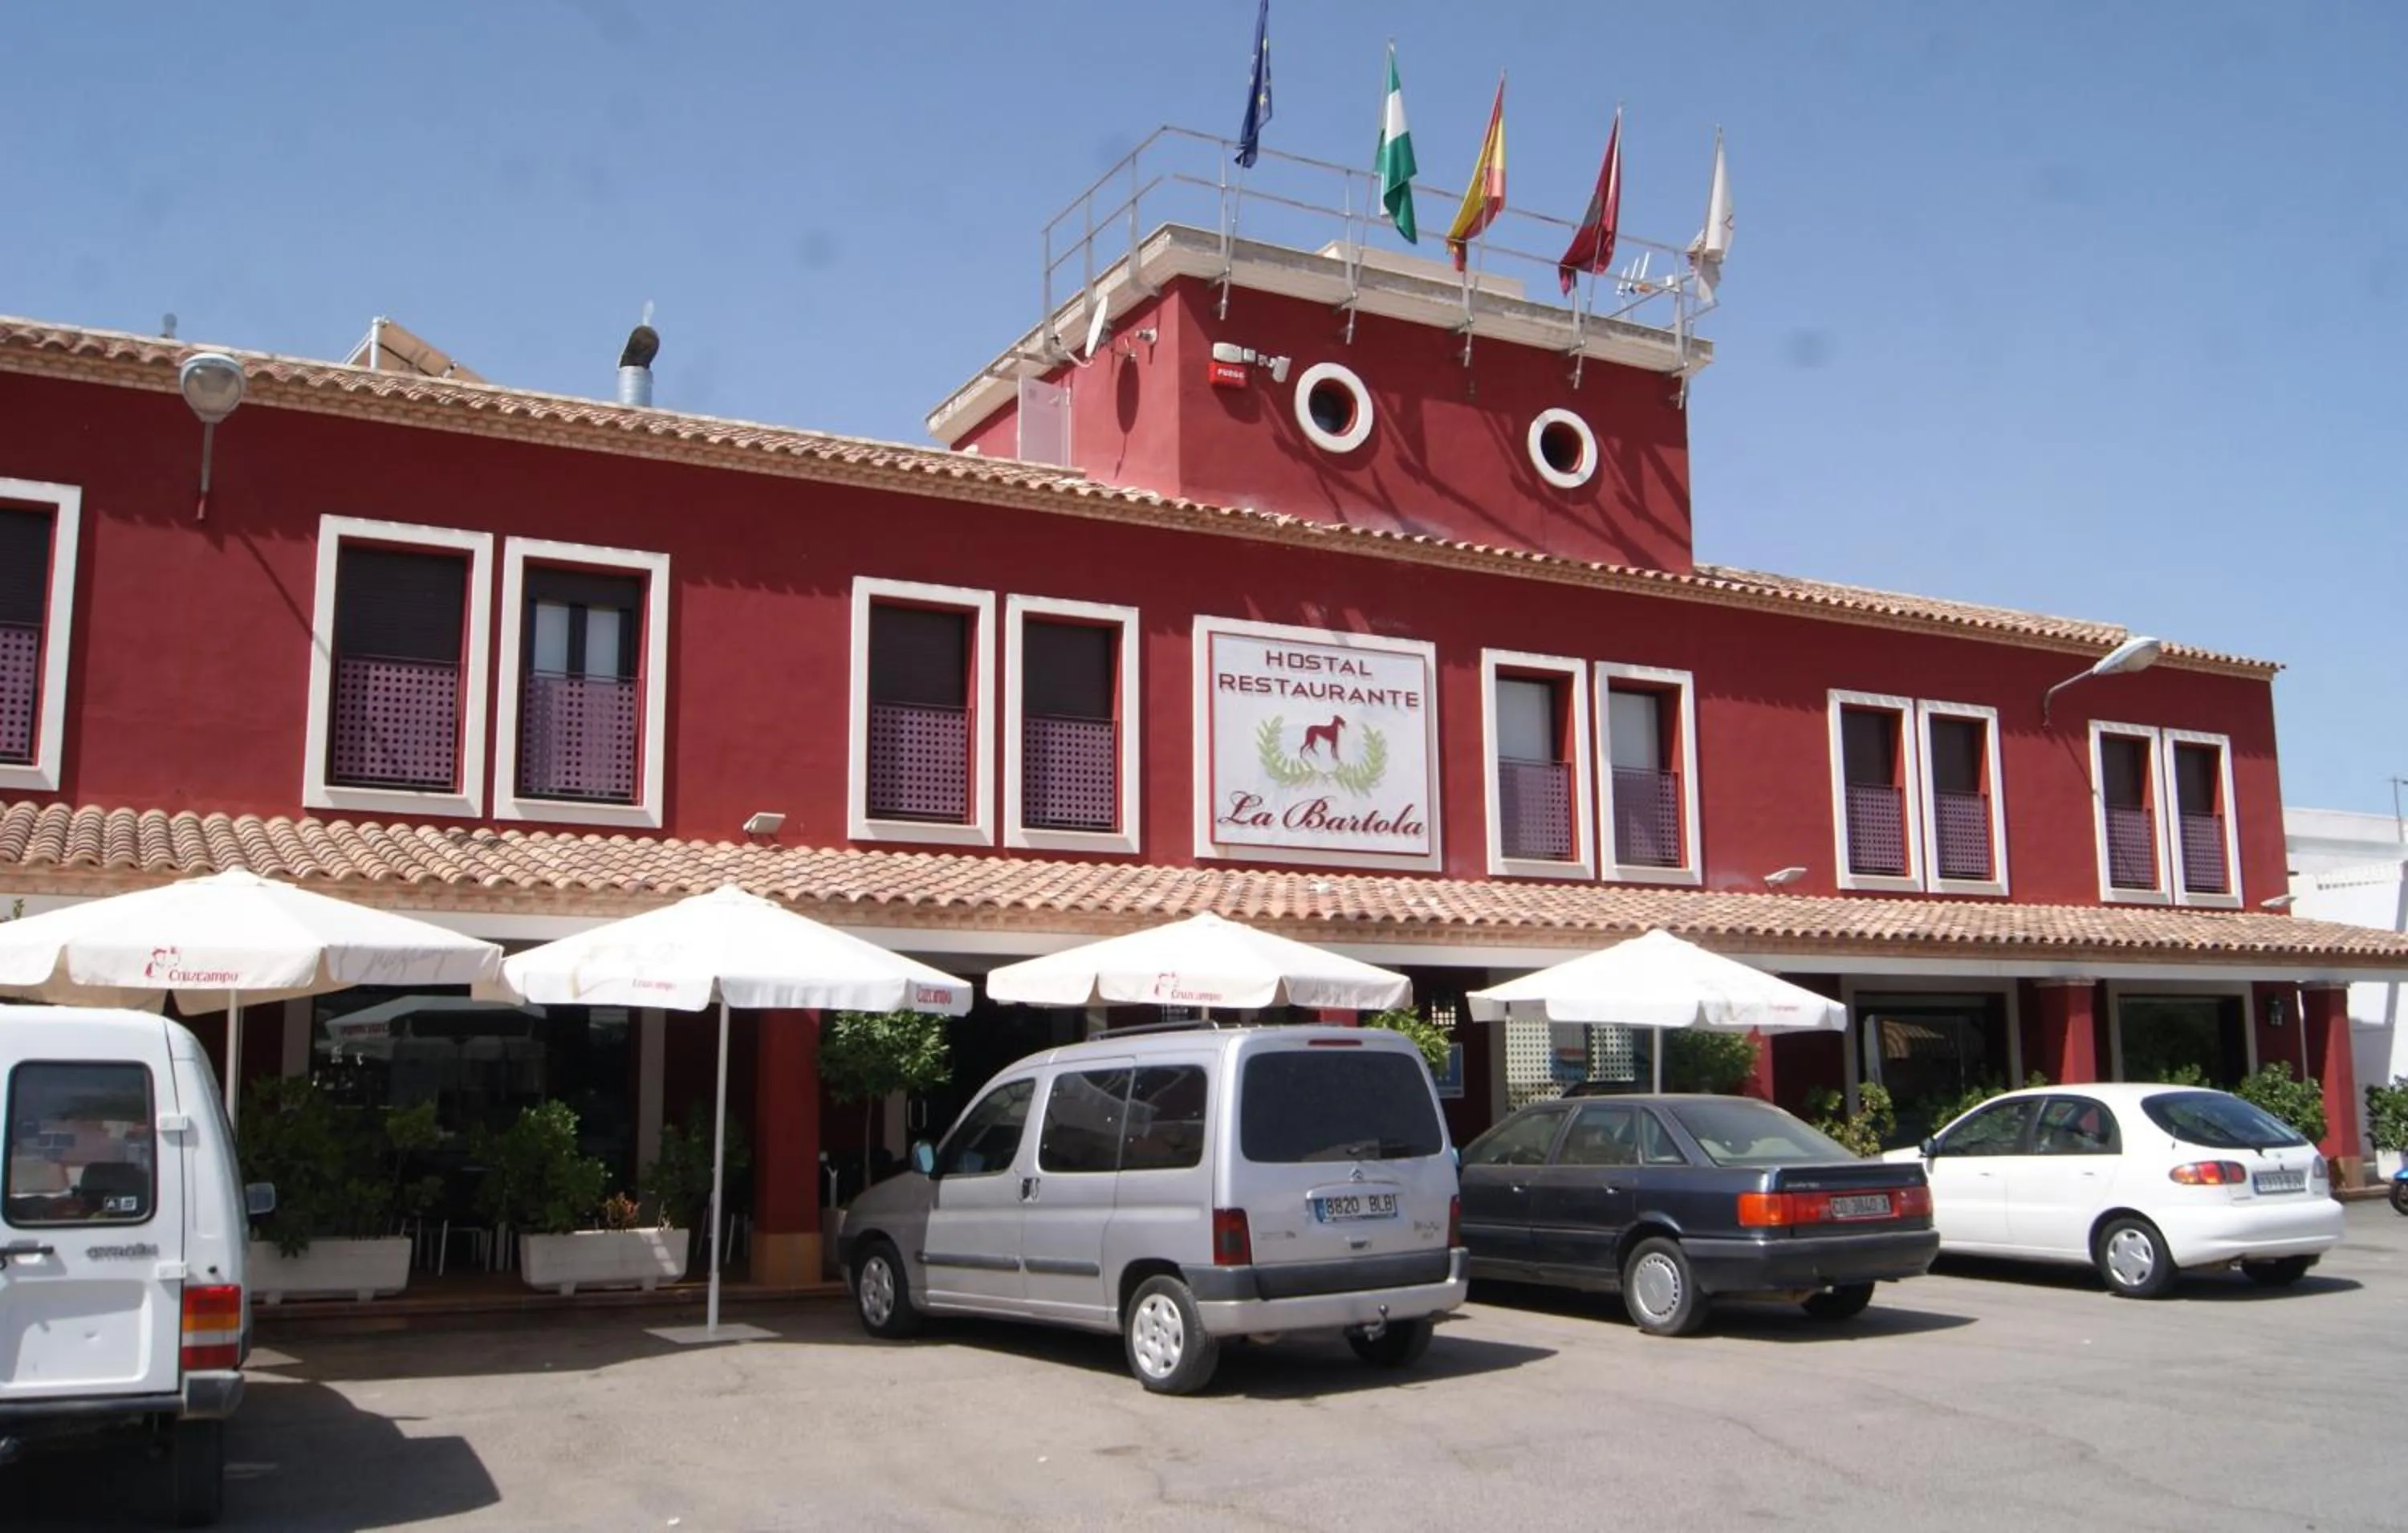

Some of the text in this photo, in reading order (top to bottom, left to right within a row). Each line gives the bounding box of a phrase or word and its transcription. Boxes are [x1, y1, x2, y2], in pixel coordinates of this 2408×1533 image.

[1266, 650, 1373, 676] HOSTAL
[1218, 673, 1419, 707] RESTAURANTE
[1217, 791, 1424, 836] La Bartola
[168, 969, 240, 983] Cruzcampo
